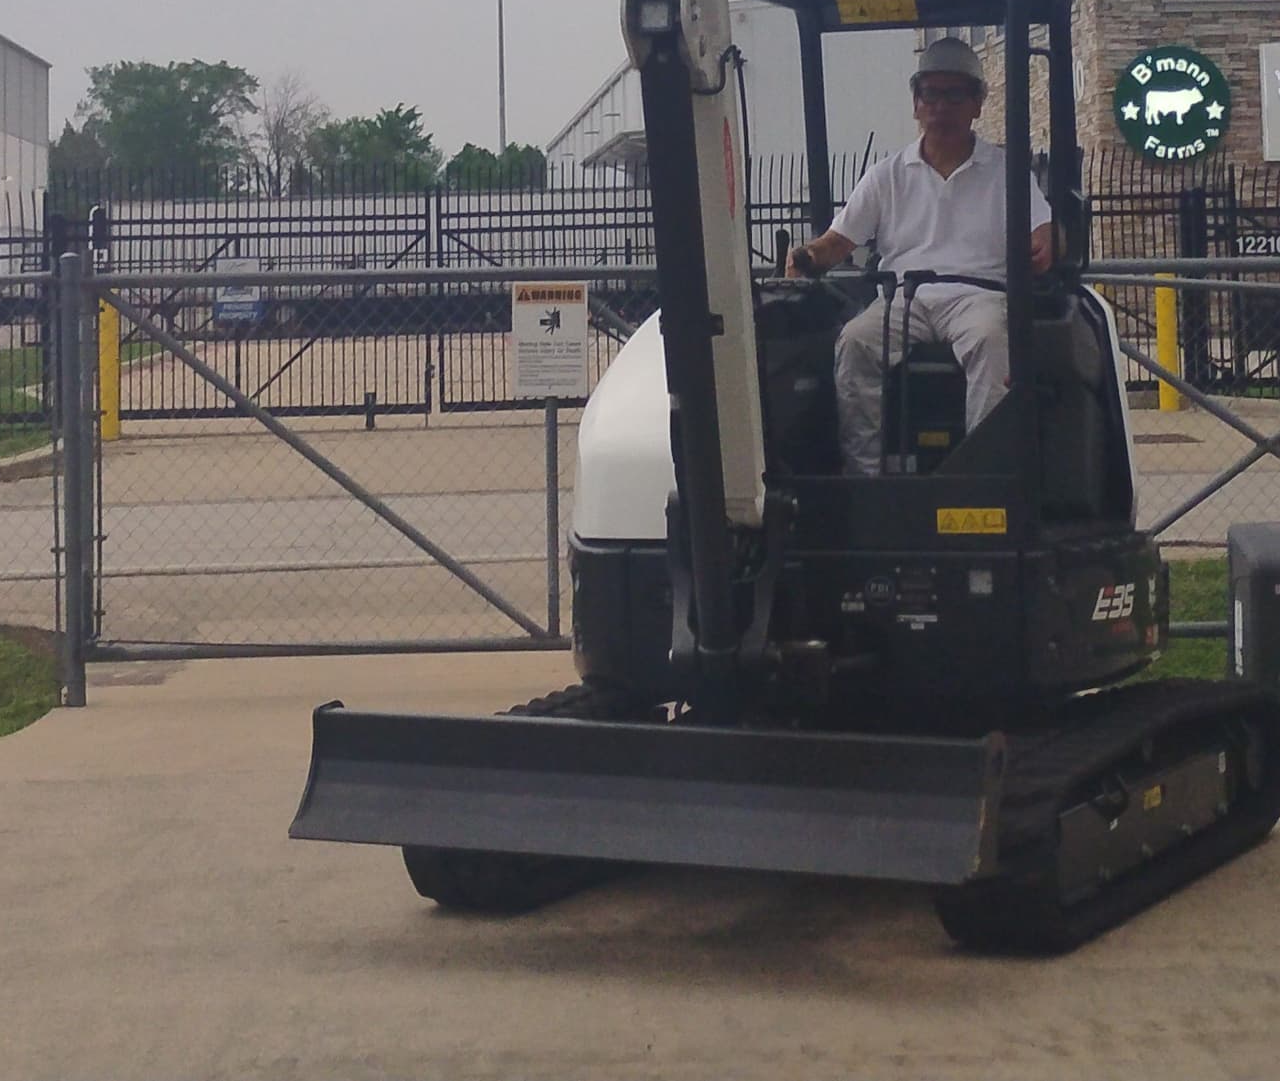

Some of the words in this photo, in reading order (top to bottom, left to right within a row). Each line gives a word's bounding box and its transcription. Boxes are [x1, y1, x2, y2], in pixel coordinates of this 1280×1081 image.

[1131, 55, 1211, 86] B'mann
[1144, 135, 1206, 160] Farms
[530, 289, 582, 301] WARNING
